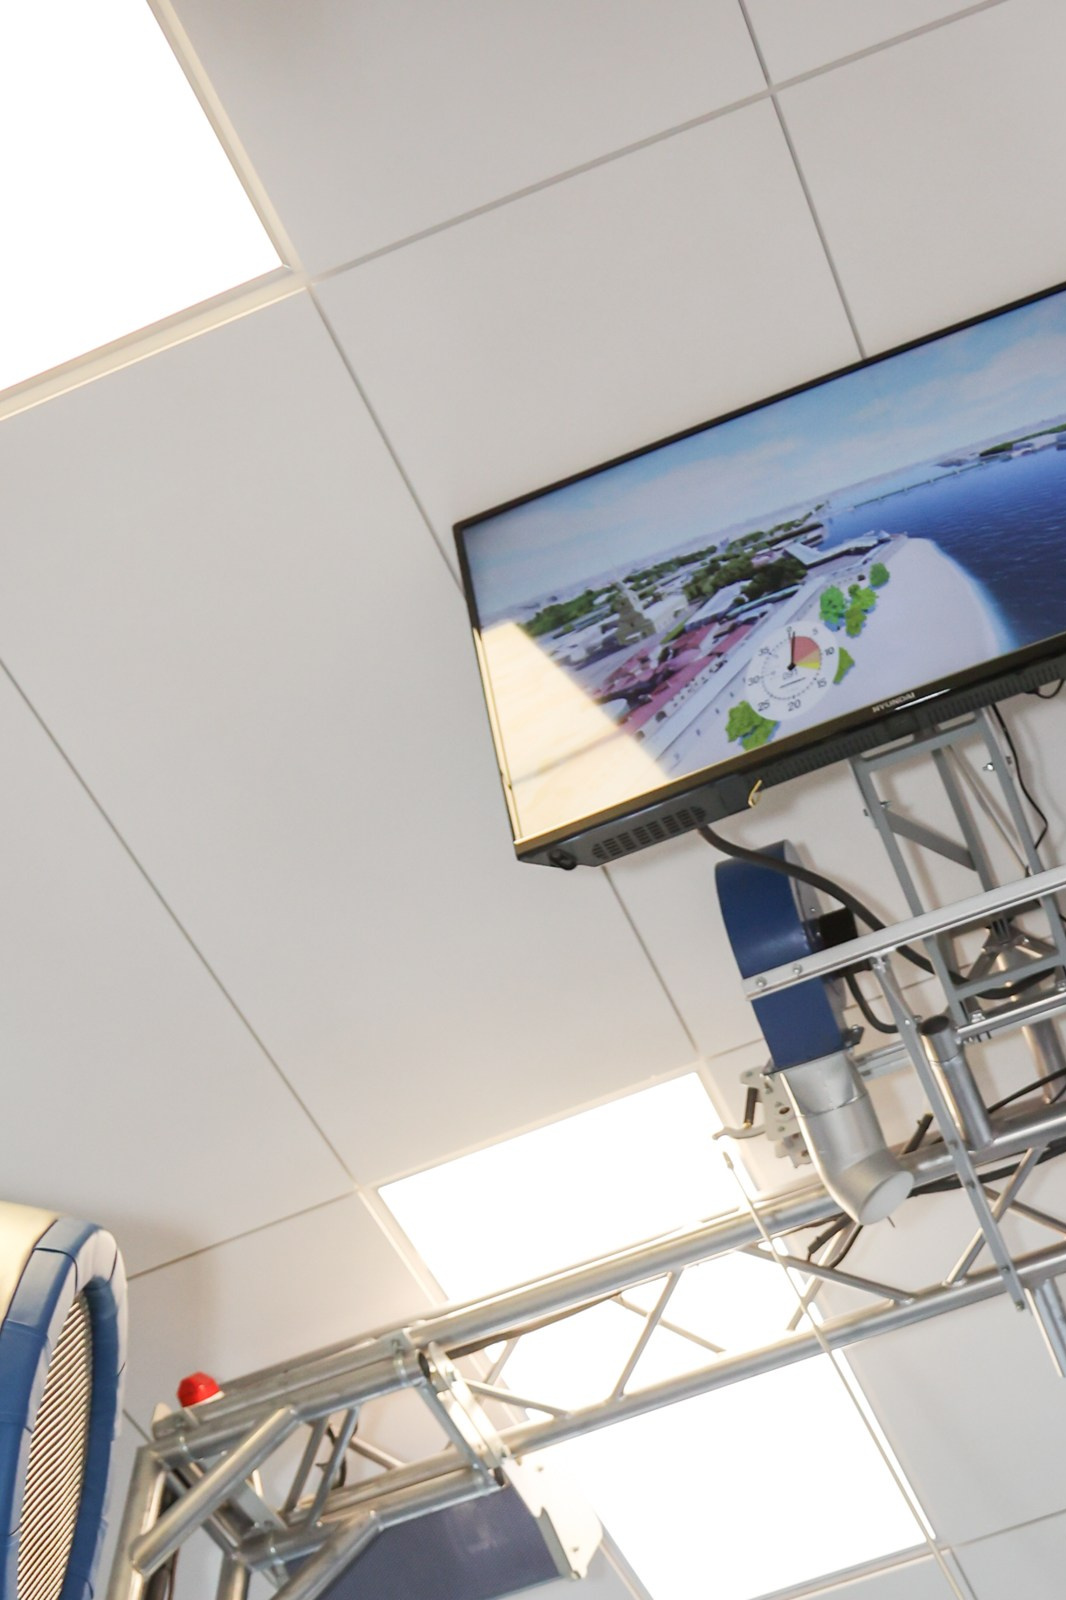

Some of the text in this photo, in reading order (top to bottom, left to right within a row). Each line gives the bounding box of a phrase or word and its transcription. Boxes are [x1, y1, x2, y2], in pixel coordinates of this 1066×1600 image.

[825, 646, 835, 656] 10
[748, 675, 761, 687] 30
[816, 677, 827, 688] 15
[758, 699, 770, 712] 25
[787, 698, 801, 712] 20
